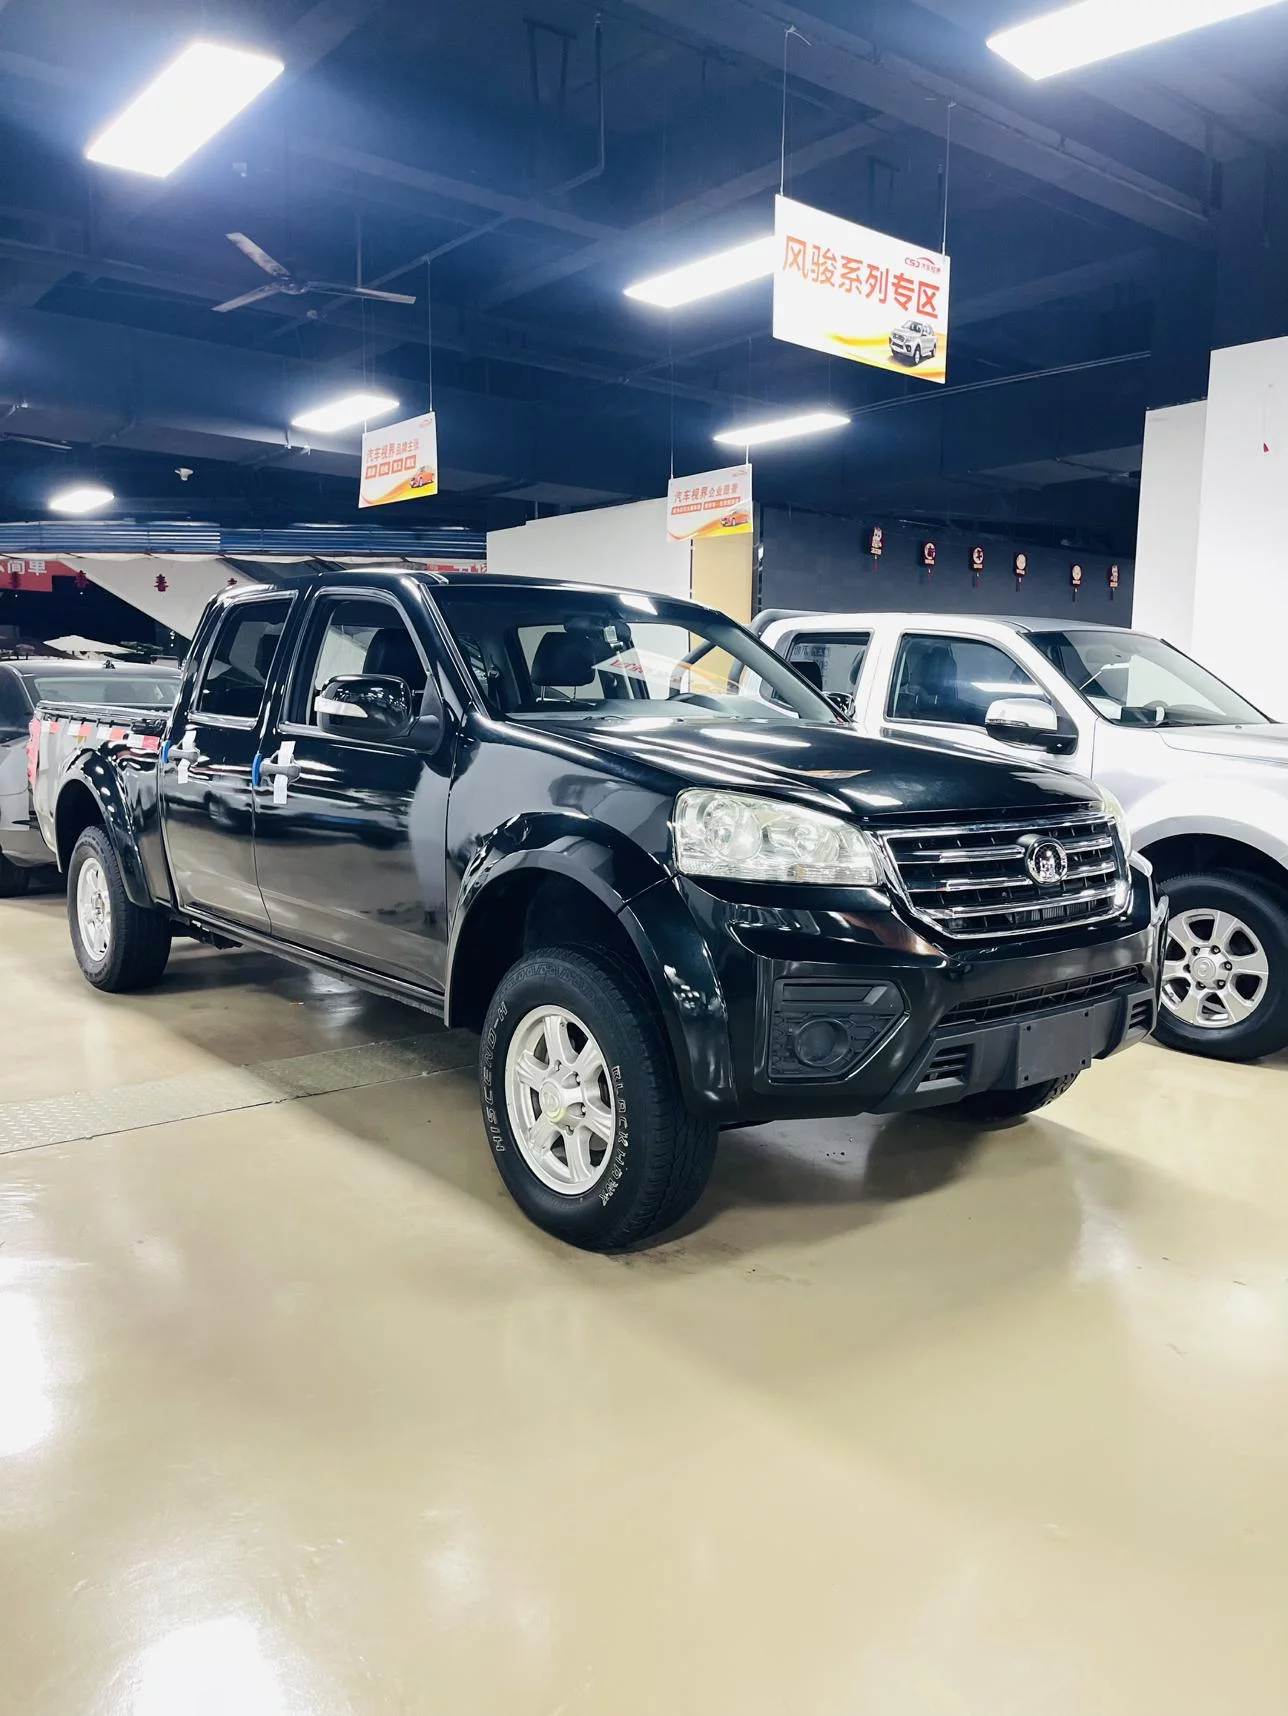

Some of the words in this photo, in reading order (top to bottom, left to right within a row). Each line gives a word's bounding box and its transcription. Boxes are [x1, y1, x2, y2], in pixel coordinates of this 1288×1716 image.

[782, 235, 940, 319] 风骏系列专区
[484, 1001, 508, 1152] HISCEND-H
[599, 1065, 629, 1207] BLACKHAWK
